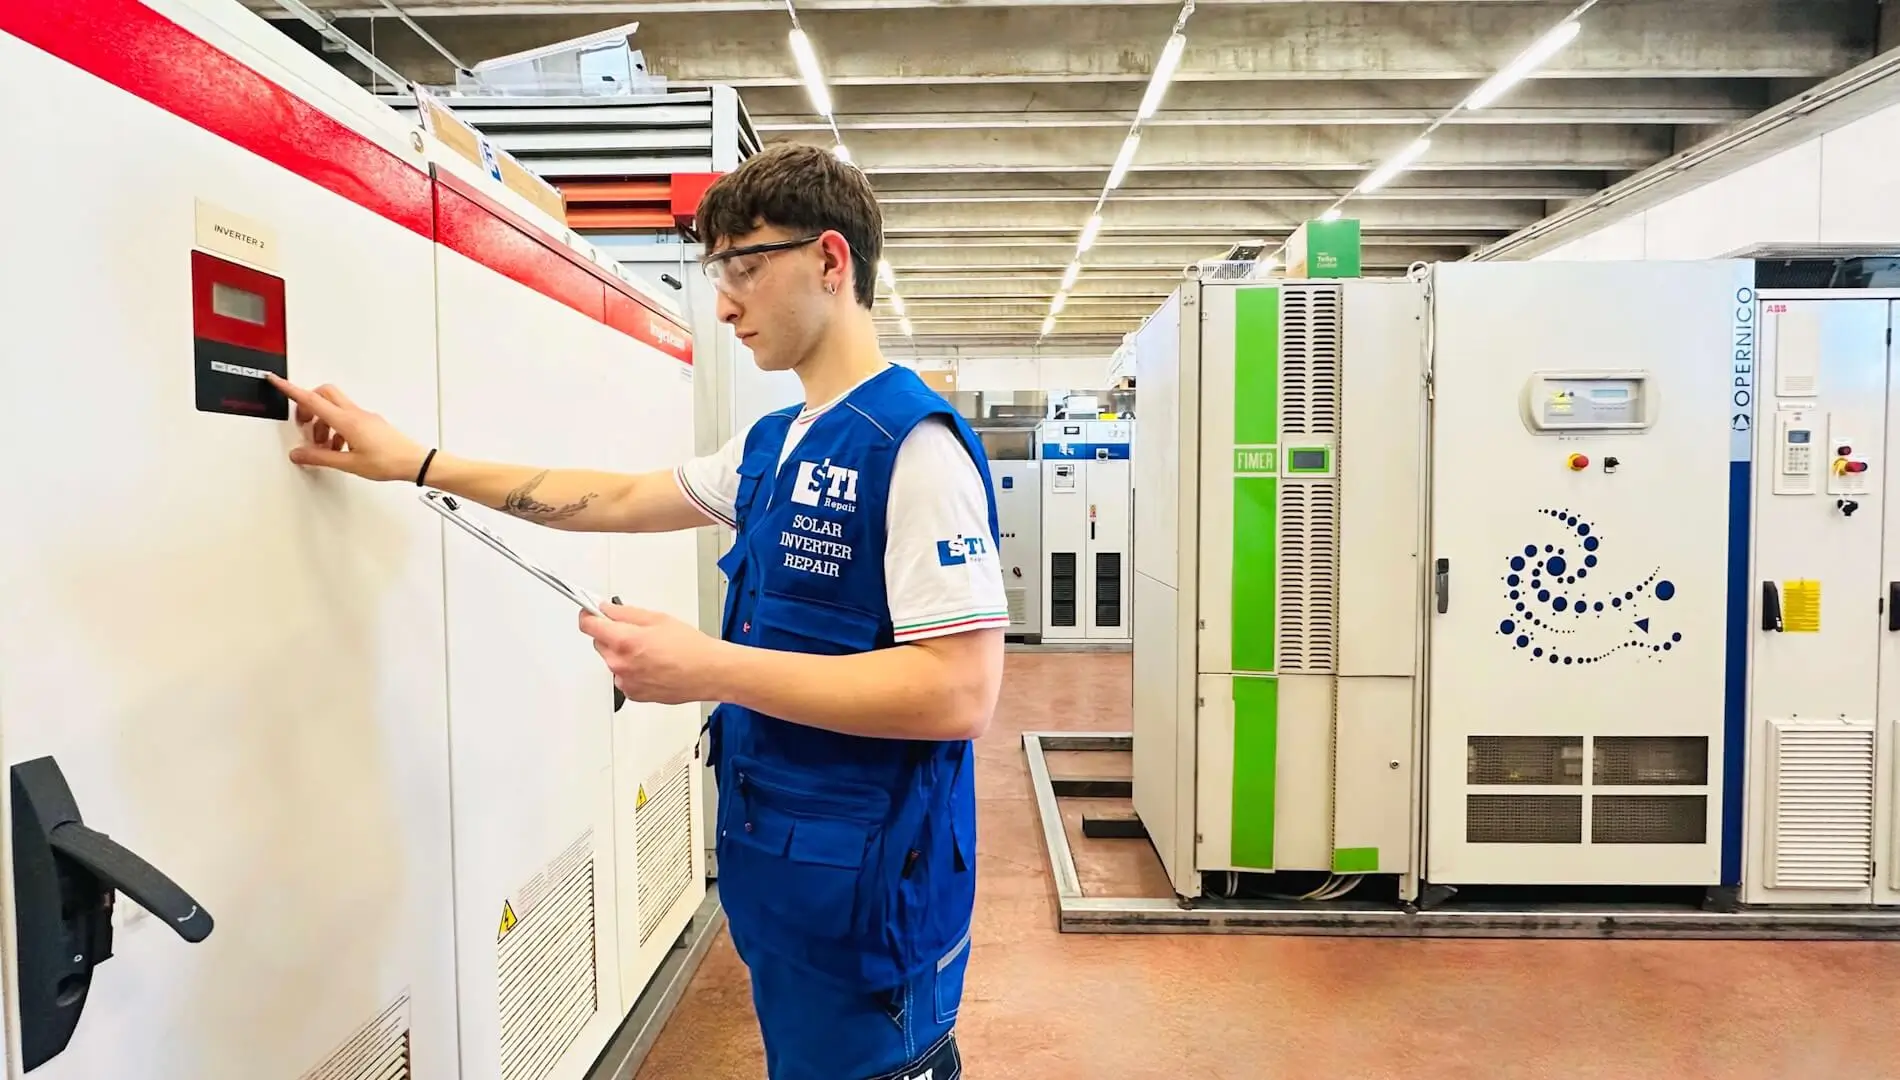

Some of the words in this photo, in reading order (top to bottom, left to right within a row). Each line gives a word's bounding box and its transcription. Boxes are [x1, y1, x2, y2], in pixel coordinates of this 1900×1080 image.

[214, 224, 258, 245] INVERTER
[259, 241, 265, 249] 2
[1766, 304, 1787, 313] ABB
[1237, 452, 1273, 470] FIMER
[806, 458, 858, 502] STI
[824, 497, 857, 513] Repair
[792, 514, 842, 538] SOLAR
[779, 531, 852, 560] INVERTER
[783, 552, 840, 577] REPAIR
